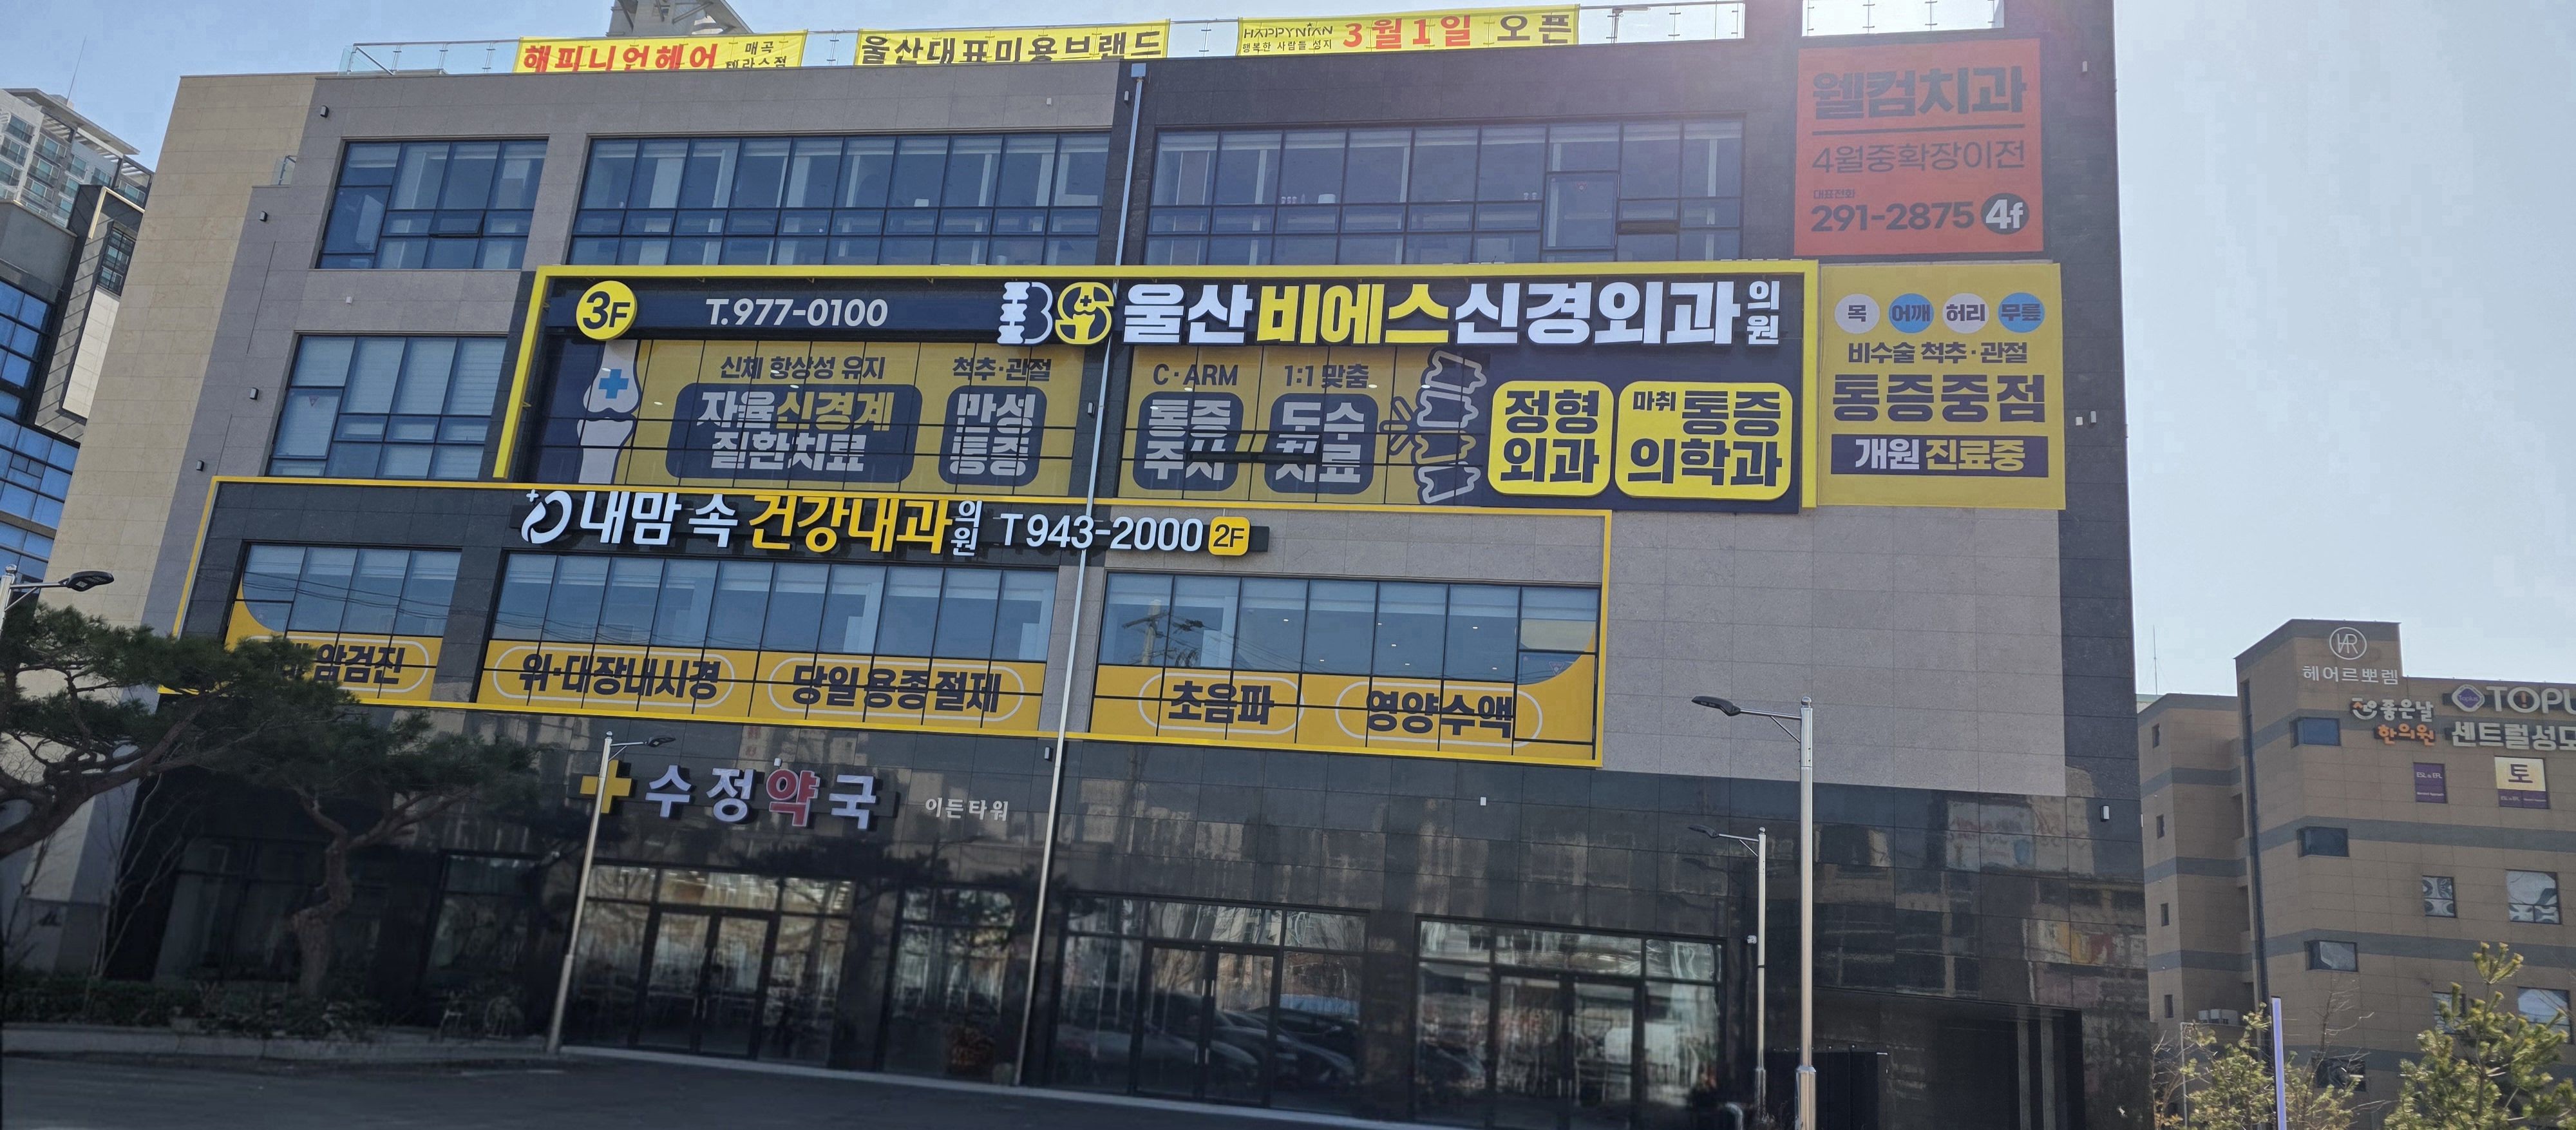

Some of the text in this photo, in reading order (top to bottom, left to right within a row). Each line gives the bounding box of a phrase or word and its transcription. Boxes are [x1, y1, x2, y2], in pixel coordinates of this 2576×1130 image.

[1242, 39, 1332, 53] 행복한 사람들 성지
[1497, 14, 1573, 45] 오픈
[523, 43, 719, 72] 해피니언헤어
[745, 41, 774, 55] 매곡
[1813, 65, 2028, 120] 웰컴치과
[1813, 188, 1856, 199] 대표전화
[1811, 198, 2024, 232] 291-2875 4f
[582, 291, 631, 330] 3F
[705, 298, 889, 328] T.977-0100
[1847, 304, 1867, 322] 목
[1891, 303, 1931, 322] 어깨
[1946, 303, 1985, 322] 허리
[2001, 303, 2041, 321] 무릎
[720, 356, 885, 381] 신체 항상성 유지
[1848, 341, 1916, 363] 비수술
[1284, 363, 1369, 389] 1:1 맞춤
[696, 390, 896, 433] 자율신경계
[956, 392, 1035, 435] 만성
[1504, 389, 1600, 434] 정형
[1633, 389, 1781, 437] 마취 통증
[1833, 374, 2046, 423] 통증중점
[1148, 397, 1231, 438] 통증
[1282, 400, 1366, 441] 도수
[710, 432, 867, 474] 질환치료
[1143, 438, 1226, 481] 주사
[1500, 437, 1600, 483] 외과
[1627, 437, 1783, 487] 의학과
[1855, 438, 2026, 472] 개원 진료중
[580, 490, 681, 546] 내맘
[687, 493, 739, 548] 속
[748, 493, 953, 555] 건강내과
[1213, 524, 1245, 548] 2F
[312, 643, 406, 685] 암검진
[2302, 666, 2398, 685] 헤어르뽀렘
[1168, 680, 1275, 725] 초음파
[1366, 688, 1515, 740] 영양수액
[2380, 698, 2434, 722] 좋은날
[2378, 723, 2435, 747] 한의원
[2508, 763, 2533, 783] 토
[645, 764, 877, 830] 수정약국
[924, 796, 1009, 821] 이든타워
